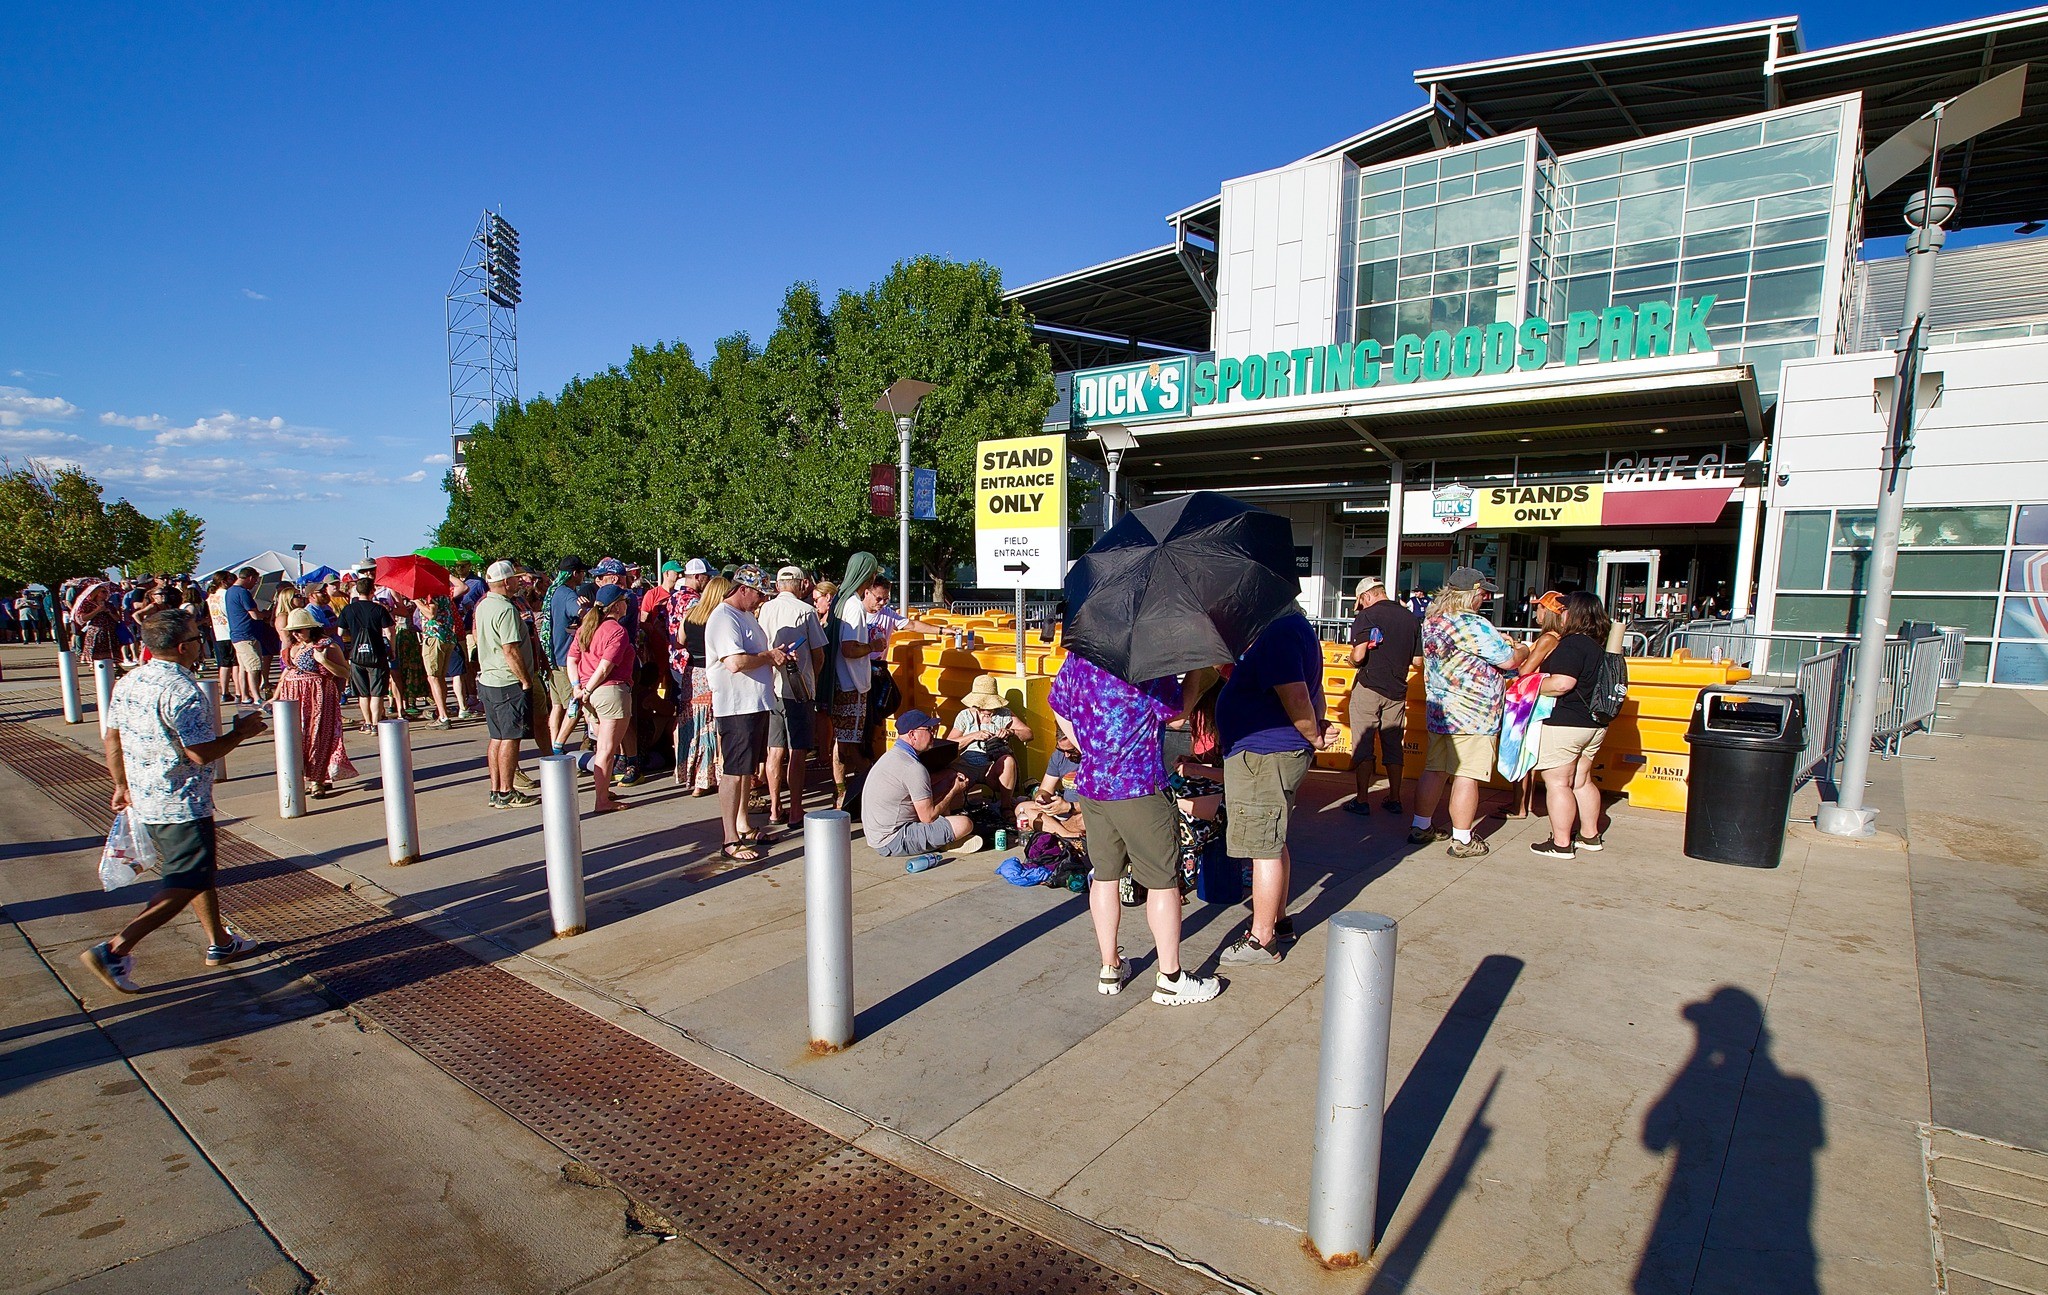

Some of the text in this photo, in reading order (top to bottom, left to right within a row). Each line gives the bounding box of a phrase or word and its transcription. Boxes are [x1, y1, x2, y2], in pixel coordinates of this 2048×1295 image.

[1079, 293, 1718, 418] DICK'S SPORTING GOODS PARK
[983, 447, 1053, 471] STAND
[1611, 453, 1719, 483] GATE G
[980, 473, 1055, 490] ENTRANCE
[989, 492, 1045, 514] ONLY
[1490, 485, 1590, 505] STANDS
[1435, 499, 1471, 514] DICK'S
[1514, 508, 1563, 521] ONLY
[1004, 536, 1029, 545] FIELD
[994, 548, 1040, 558] ENTRANCE
[1652, 766, 1684, 777] MASH
